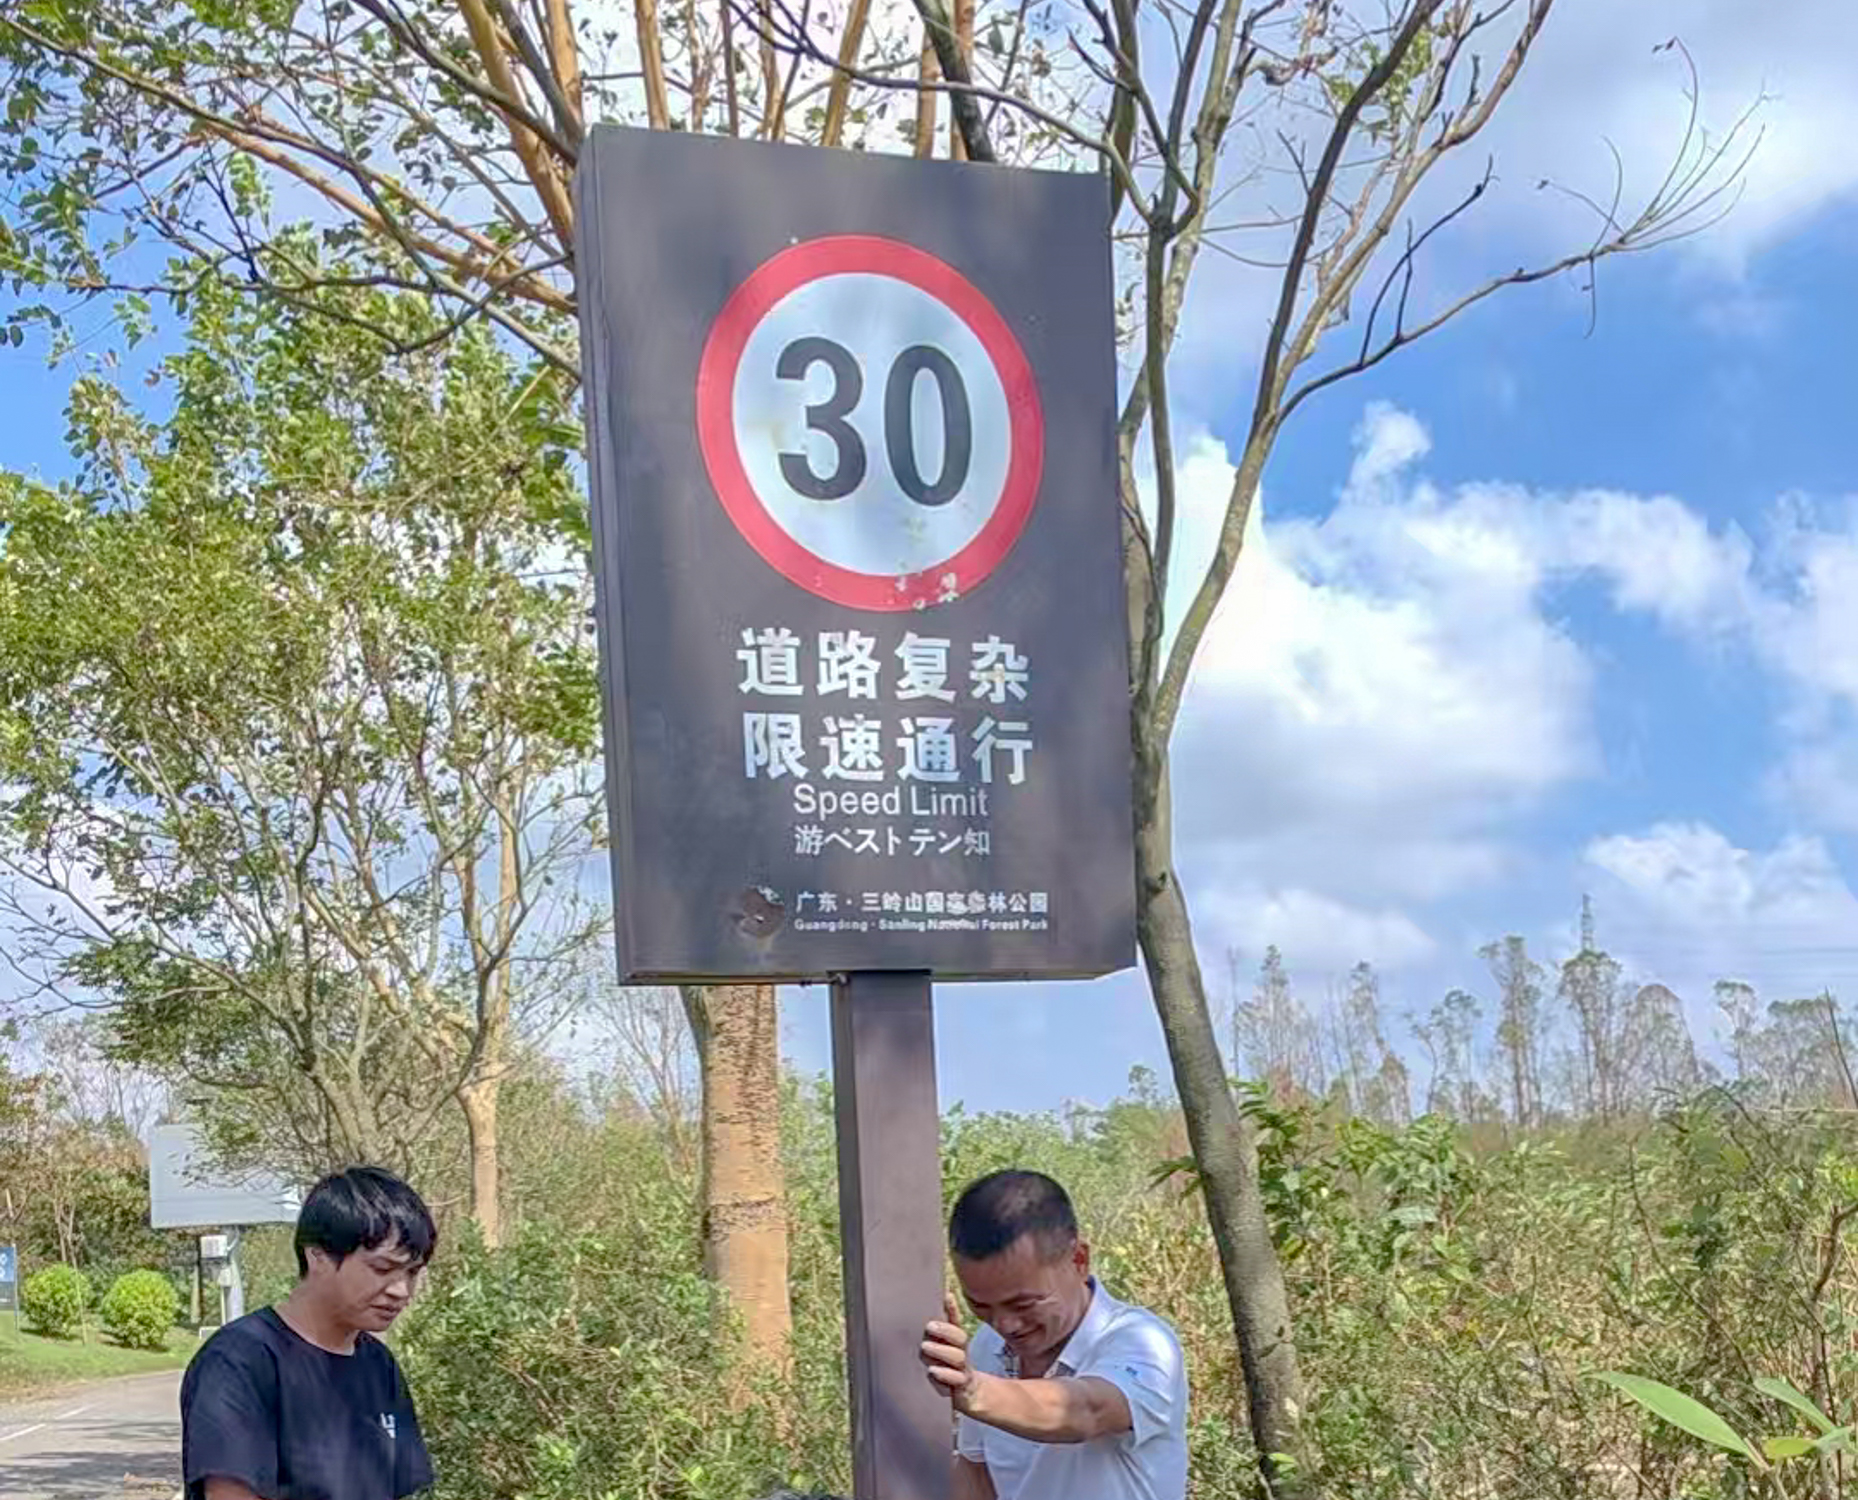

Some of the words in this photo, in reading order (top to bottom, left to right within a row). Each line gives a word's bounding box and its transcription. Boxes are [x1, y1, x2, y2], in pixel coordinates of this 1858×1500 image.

[775, 336, 972, 506] 30
[736, 627, 1029, 704] 道路复杂
[743, 711, 1033, 786] 限速通行
[793, 782, 900, 821] Speed
[911, 785, 988, 816] Limit
[981, 918, 1021, 932] Forest
[1021, 918, 1049, 932] Park
